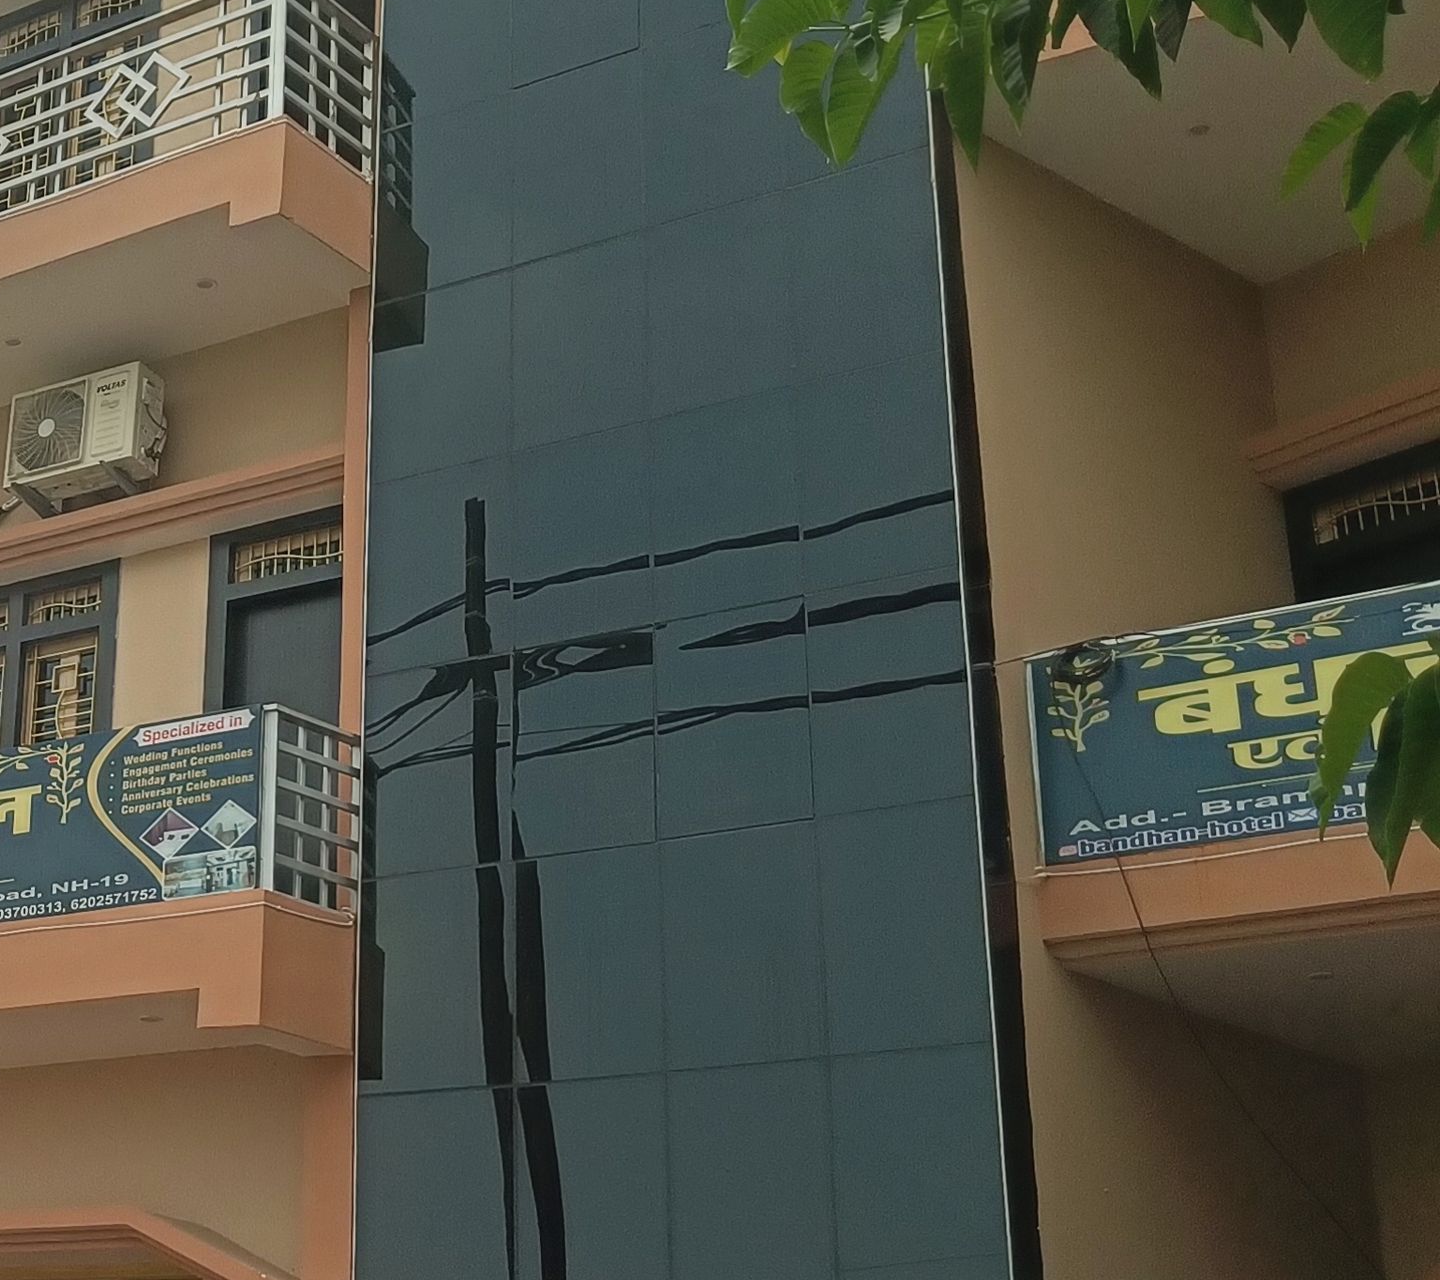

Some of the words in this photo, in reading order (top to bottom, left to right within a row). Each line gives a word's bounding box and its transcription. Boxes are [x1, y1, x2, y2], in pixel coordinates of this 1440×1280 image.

[142, 718, 224, 743] Specialized
[229, 715, 243, 727] in
[122, 758, 187, 778] Engagement
[190, 747, 253, 766] Ceremonies
[123, 750, 168, 765] Wedding
[171, 740, 223, 756] Functions
[121, 784, 182, 802] Anniversary
[186, 773, 254, 792] Celebrations
[122, 774, 166, 790] Birthday
[169, 768, 207, 783] Parties
[121, 799, 172, 815] Corporate
[176, 793, 211, 806] Events
[1078, 811, 1285, 857] bandhan-hotel
[51, 873, 130, 896] NH-19
[70, 887, 158, 911] 6202571752
